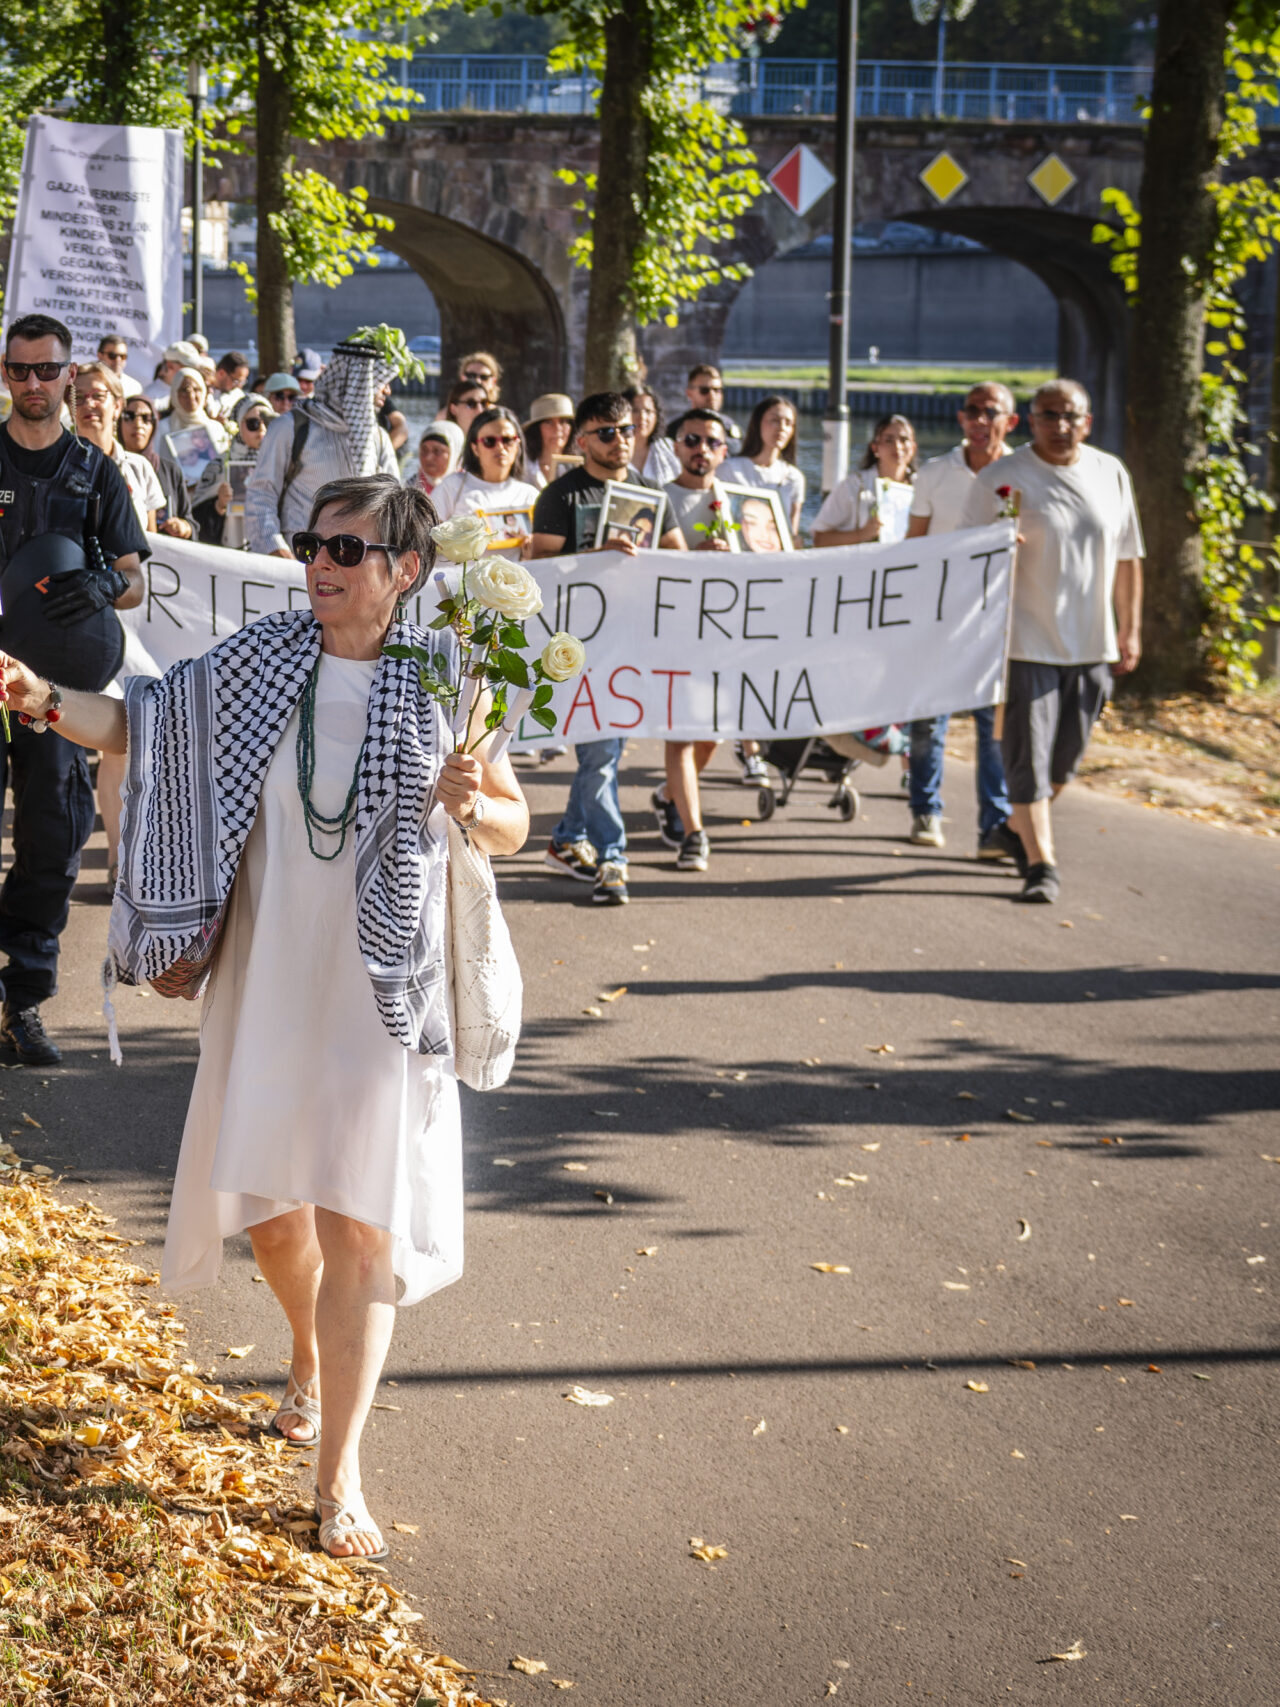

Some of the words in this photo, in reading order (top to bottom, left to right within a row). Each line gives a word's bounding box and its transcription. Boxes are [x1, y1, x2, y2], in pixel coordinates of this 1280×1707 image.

[46, 180, 87, 195] GAZAS
[41, 209, 115, 230] MINDESTENS
[59, 227, 106, 241] KINDER
[108, 233, 134, 246] SIND
[33, 297, 77, 311] UNTER
[65, 315, 102, 328] ODER
[104, 320, 118, 331] IN
[653, 548, 1008, 640] FREIHEIT
